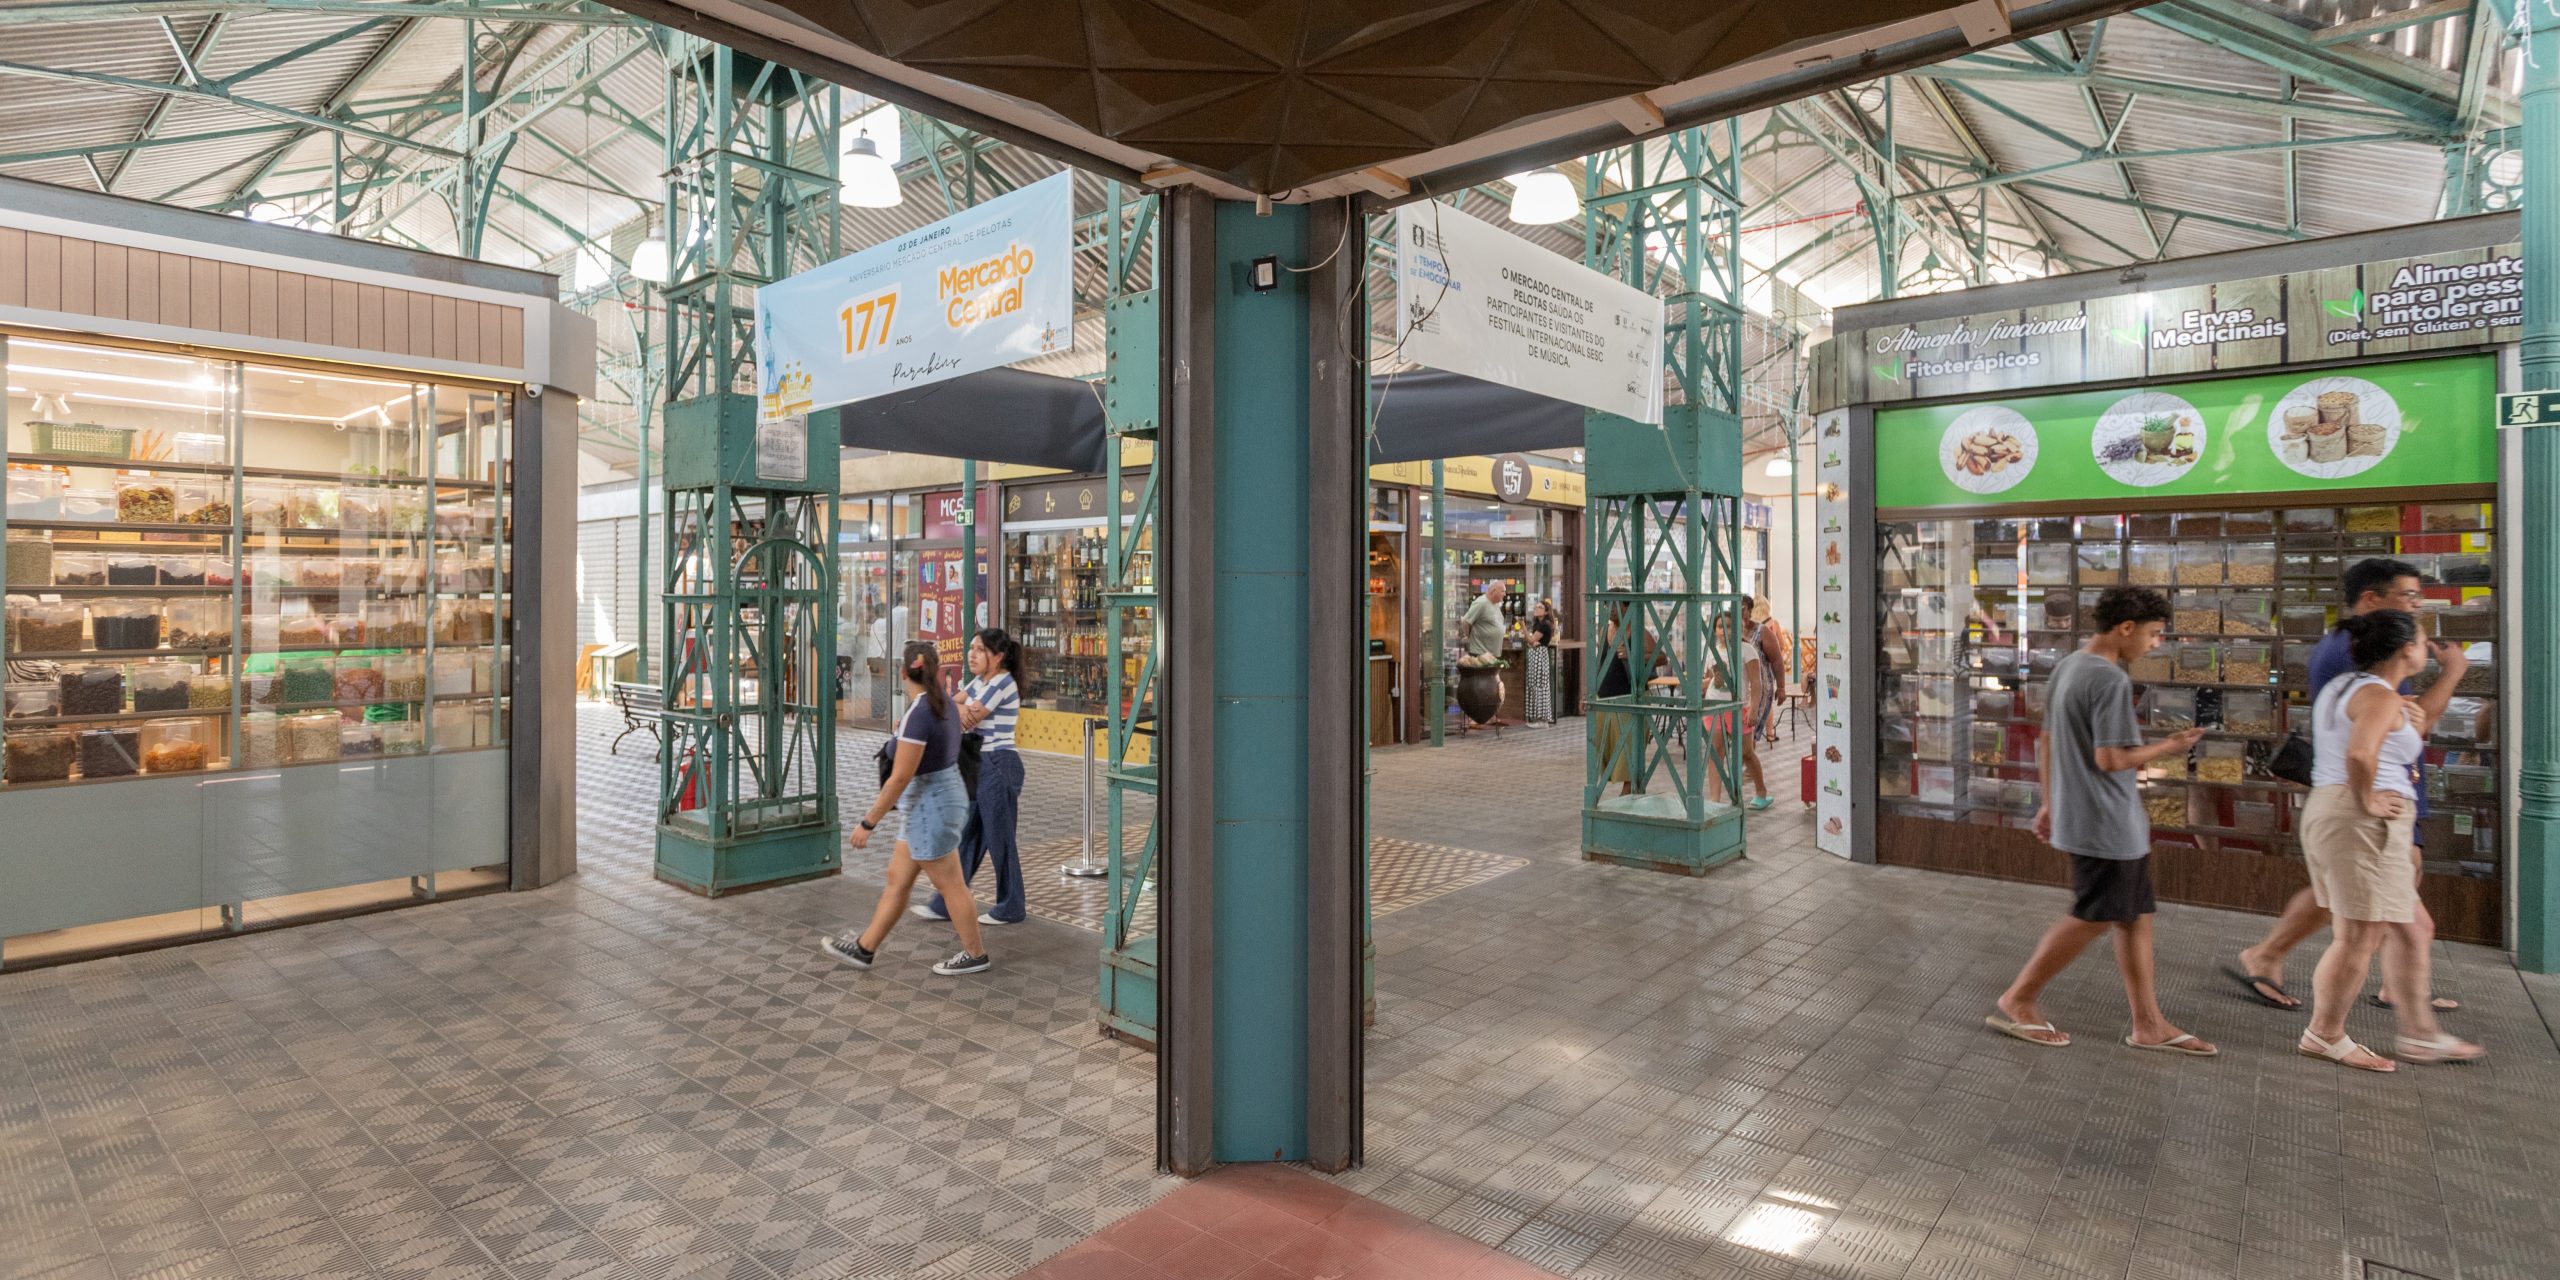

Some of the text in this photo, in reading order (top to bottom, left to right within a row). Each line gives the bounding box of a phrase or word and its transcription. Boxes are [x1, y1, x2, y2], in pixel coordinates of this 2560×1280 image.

[848, 217, 1013, 284] ANIVERSÁRIO MERCADO CENTRAL DE PELOTAS
[898, 226, 951, 252] 03 DE JANEIRO
[939, 244, 1034, 300] Mercado
[1419, 255, 1443, 273] TEMPO
[1419, 267, 1461, 292] EMOCIONAR
[947, 277, 1023, 328] Central
[1501, 267, 1594, 313] O MERCADO CENTRAL DE
[2371, 288, 2438, 313] para
[1487, 296, 1548, 328] PARTICIPANTES
[1554, 320, 1594, 344] VISITANTES
[1595, 334, 1605, 348] DO
[1513, 289, 1584, 325] PELOTAS SAÚDA OS
[2183, 308, 2254, 329] Ervas
[2383, 297, 2524, 325] intoleran
[841, 292, 897, 354] 177
[1488, 314, 1526, 337] FESTIVAL
[1527, 328, 1586, 357] INTERNACIONAL
[1586, 347, 1604, 362] SESC
[1877, 310, 2088, 354] Alimentos funcionais
[2152, 318, 2287, 349] Medicinais
[2328, 329, 2373, 345] (Diet,
[2376, 326, 2410, 338] sem
[2413, 319, 2469, 335] Glúten
[2475, 320, 2486, 329] e
[896, 334, 912, 346] ANOS
[892, 352, 962, 385] Parabéns
[1528, 344, 1571, 368] DE MÚSICA.
[1905, 350, 2041, 379] Fitoterápicos
